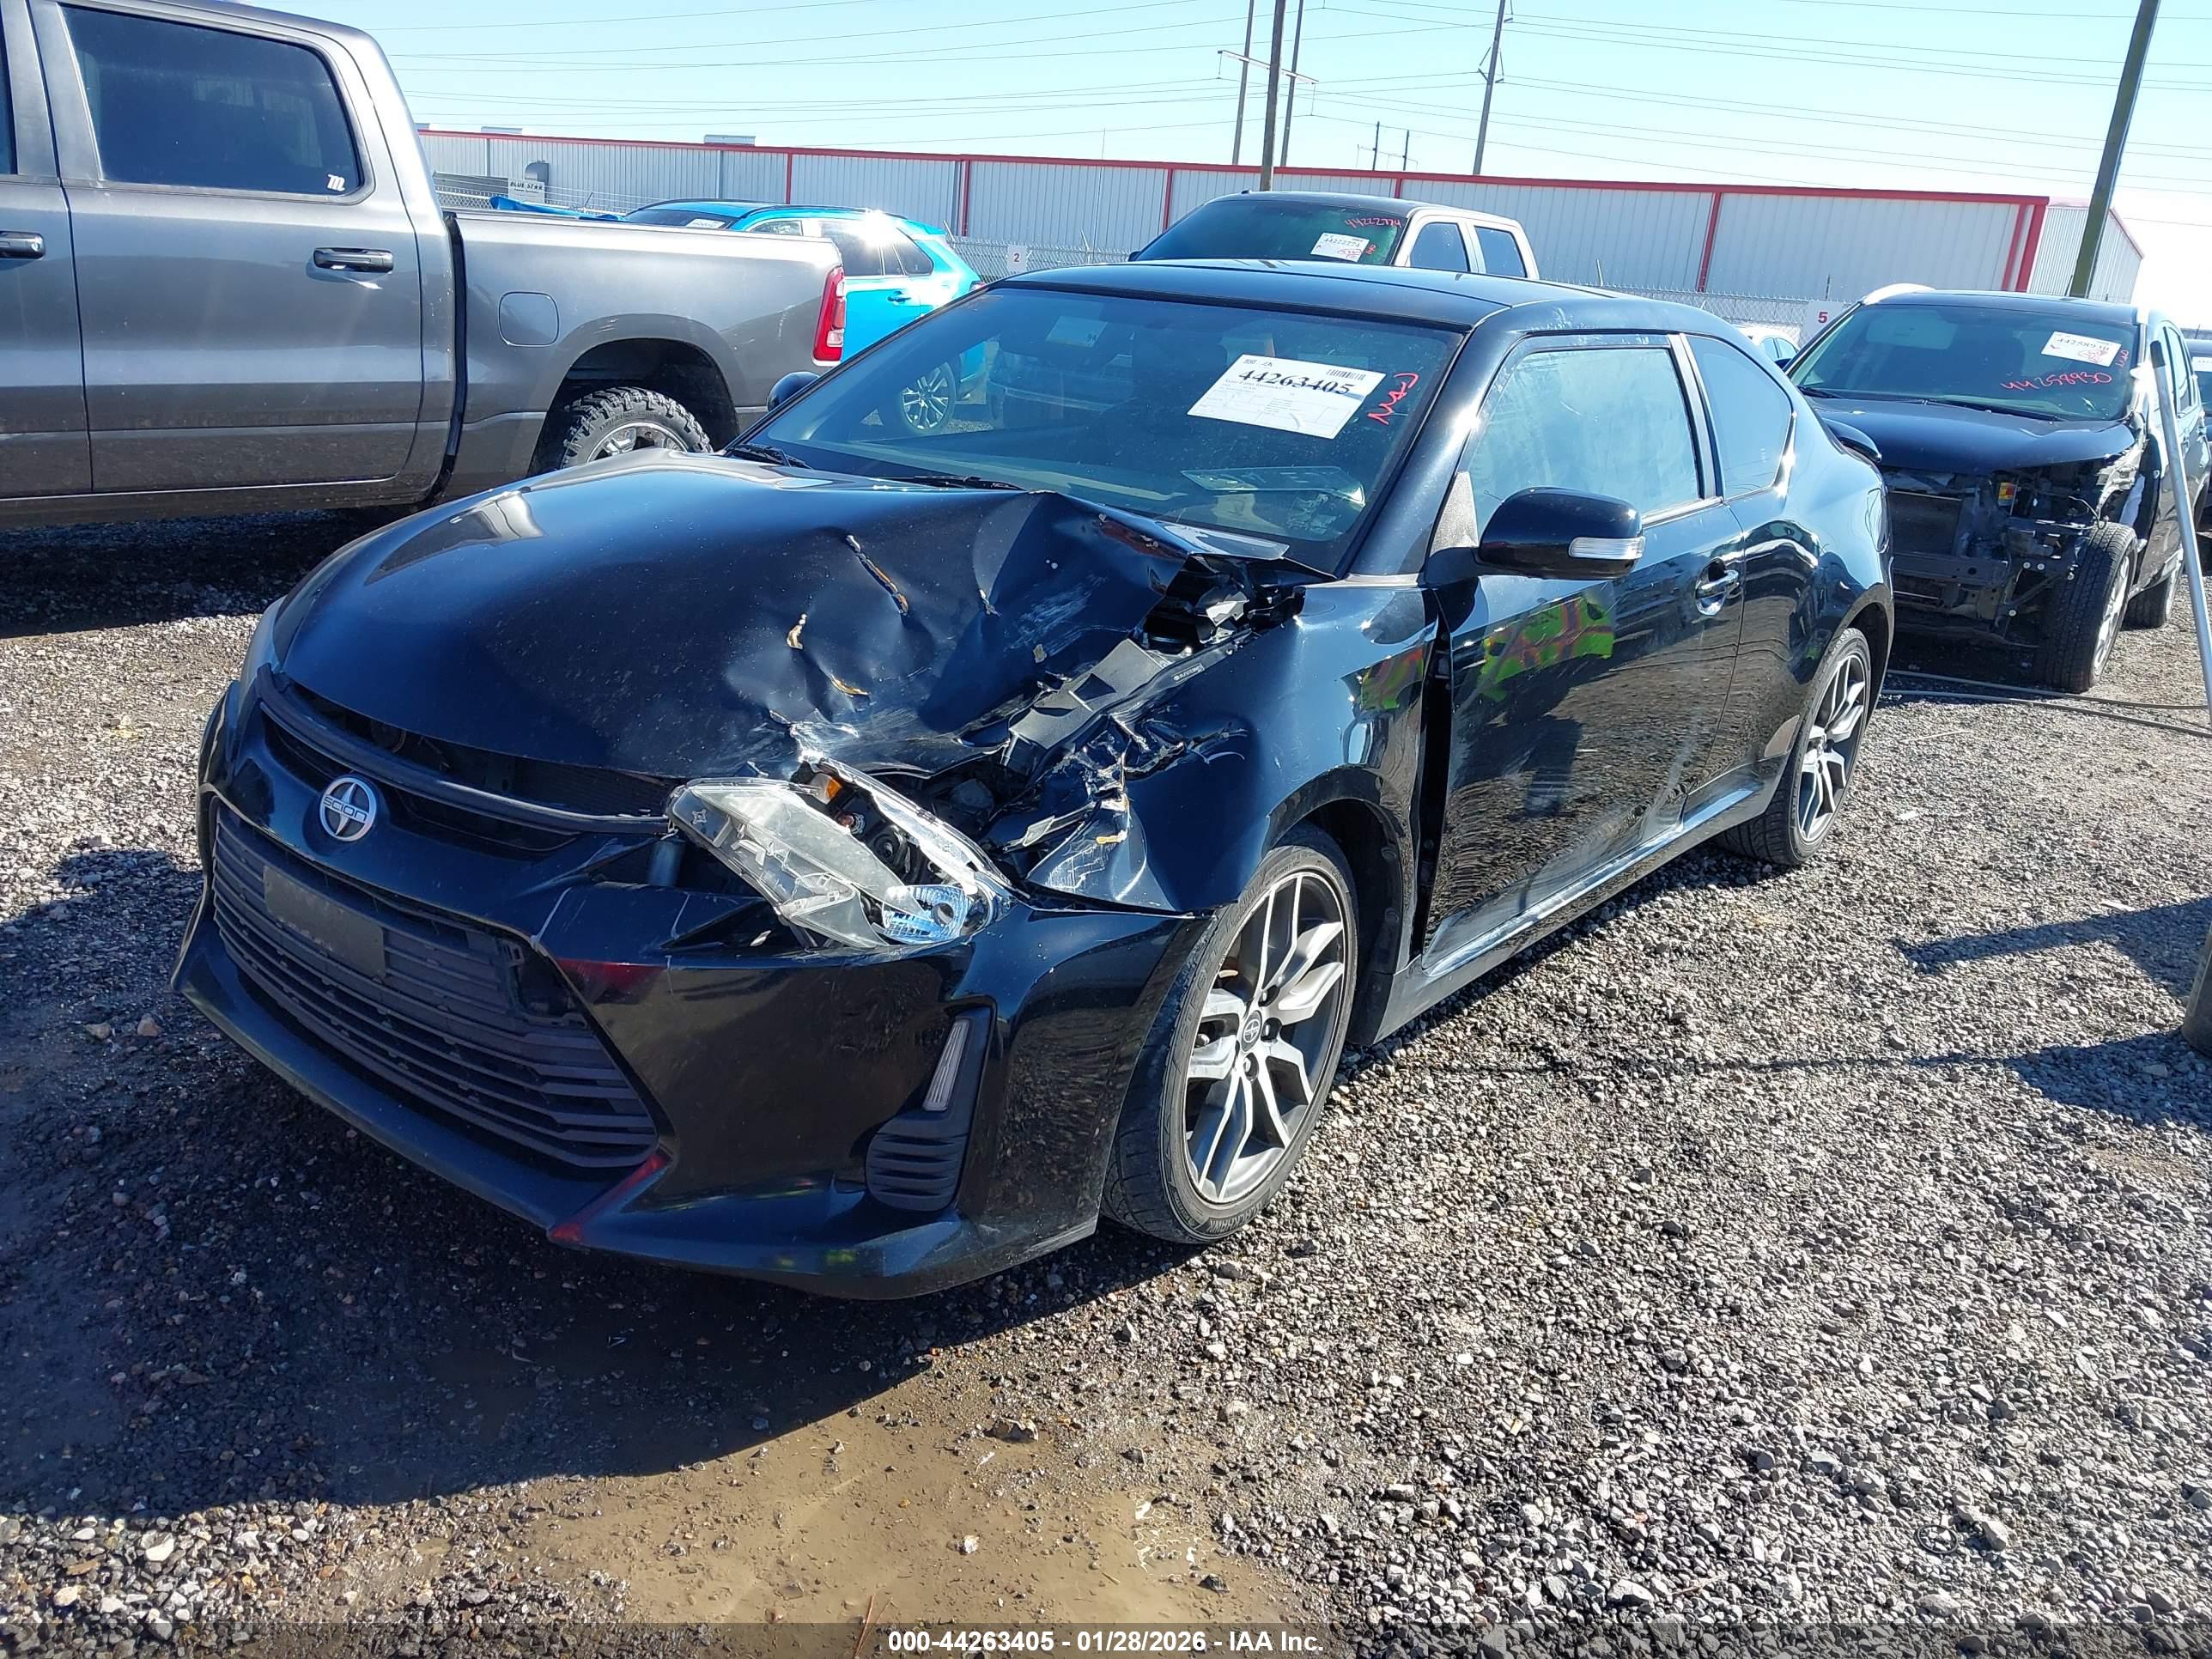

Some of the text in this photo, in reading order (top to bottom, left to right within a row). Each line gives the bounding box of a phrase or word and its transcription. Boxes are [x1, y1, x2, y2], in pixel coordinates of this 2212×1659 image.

[1345, 218, 1401, 228] 44222774
[1013, 252, 1020, 263] 2
[1818, 311, 1828, 324] 5
[1238, 369, 1356, 395] 44263405
[2000, 371, 2112, 391] 44258930
[323, 796, 368, 822] SCION
